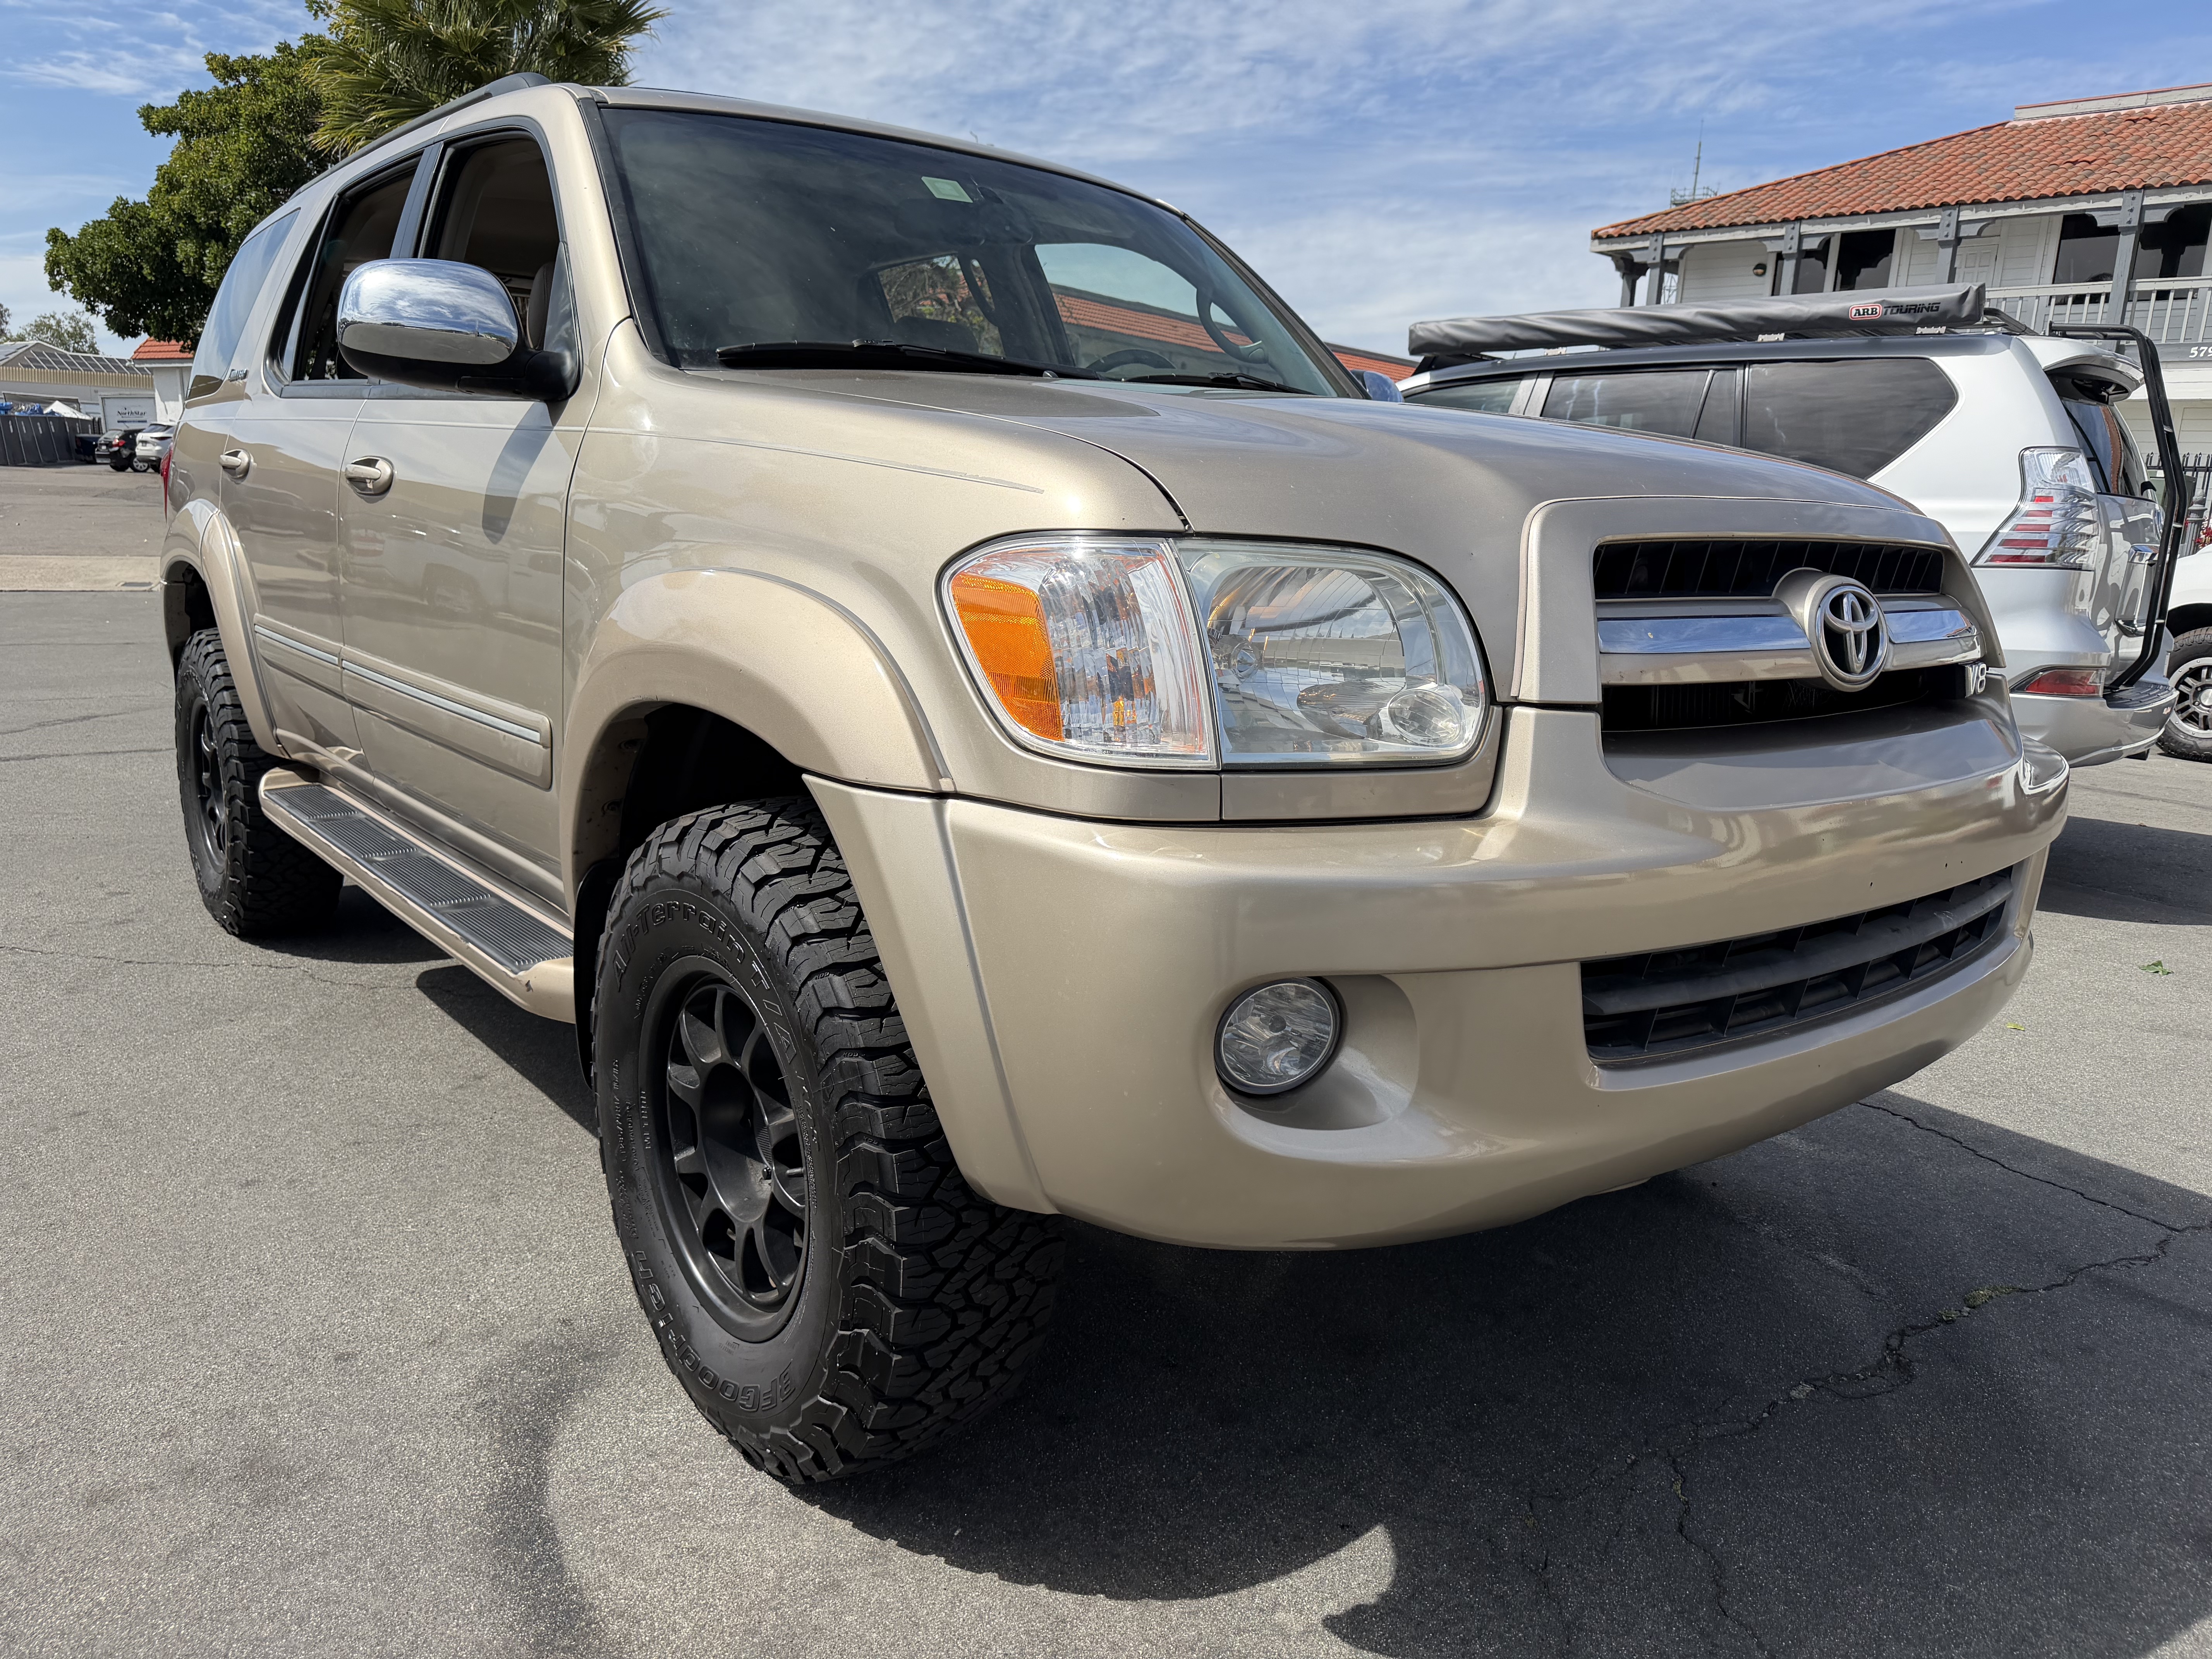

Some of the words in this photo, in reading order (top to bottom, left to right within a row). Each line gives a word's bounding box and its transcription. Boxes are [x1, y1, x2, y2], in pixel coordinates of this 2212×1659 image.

[1854, 307, 1878, 316] ARB
[1884, 302, 1941, 315] TOURING
[1966, 663, 1987, 697] V8
[613, 901, 745, 992] All-Terrain
